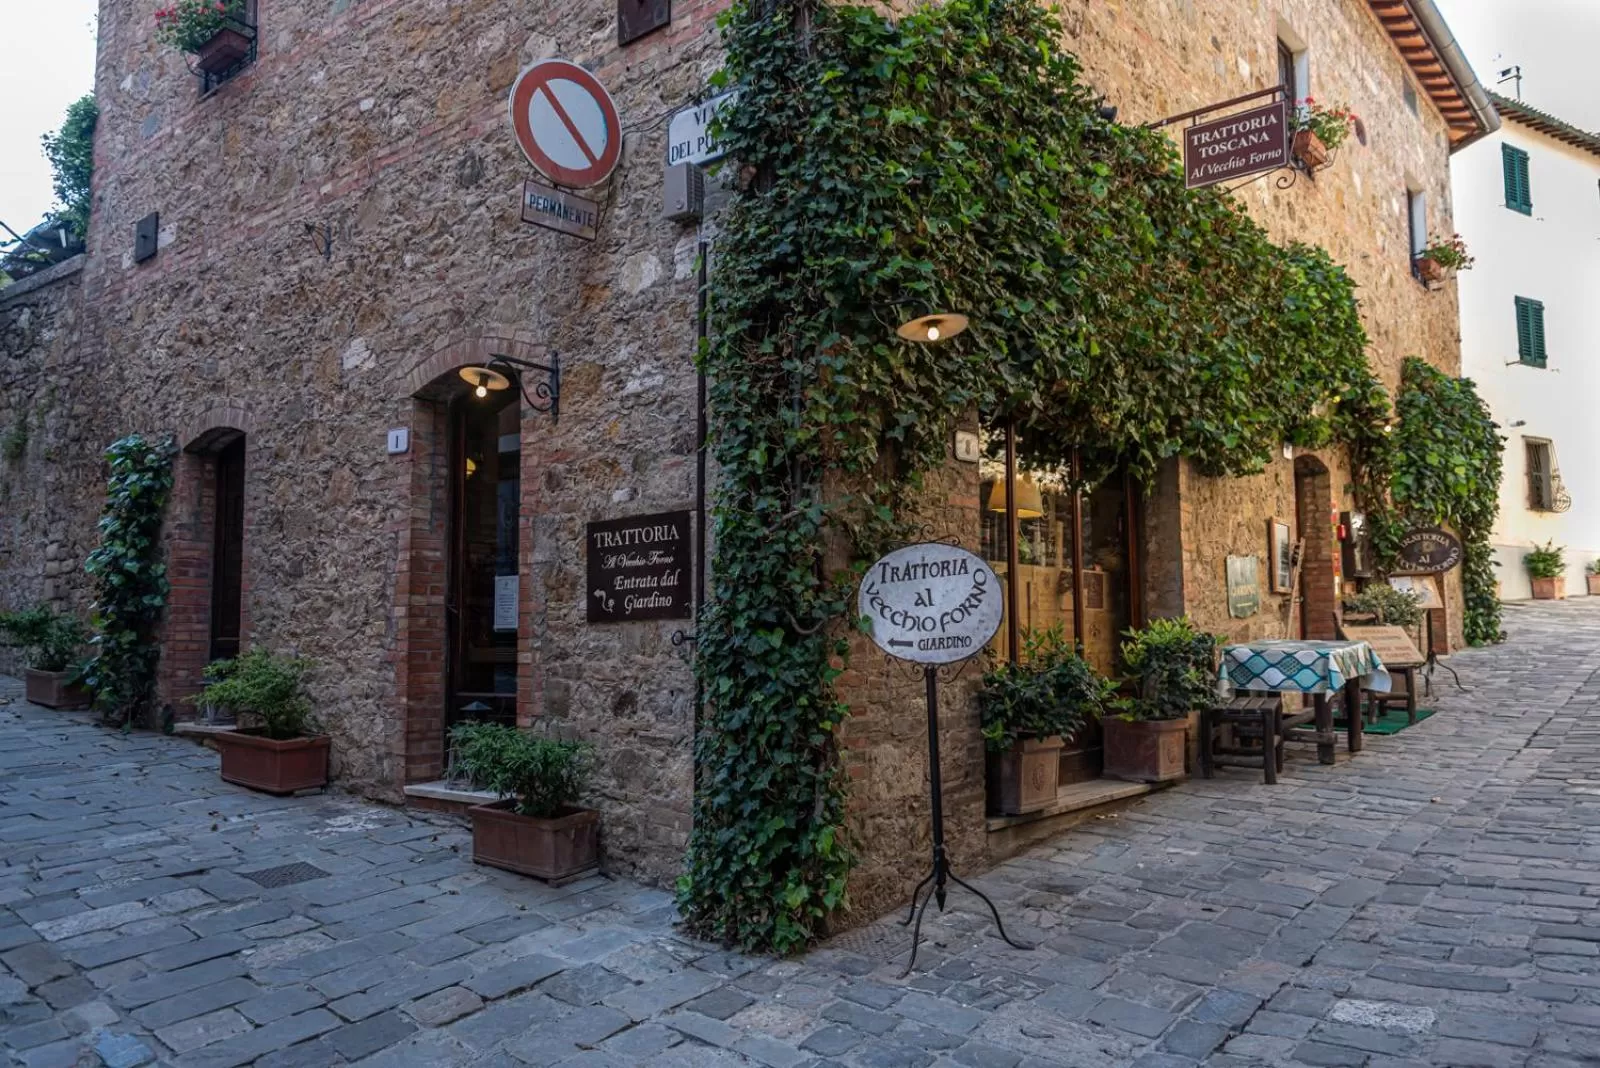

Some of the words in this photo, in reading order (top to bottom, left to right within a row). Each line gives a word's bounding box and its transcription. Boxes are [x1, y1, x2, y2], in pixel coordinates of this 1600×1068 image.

[1191, 113, 1278, 146] TRATTORIA
[671, 141, 694, 163] DEL
[1198, 131, 1270, 159] TOSCANA
[1190, 163, 1206, 179] Al
[1207, 156, 1246, 176] Vecchio
[1248, 148, 1282, 165] Forno
[529, 193, 595, 229] PERMANENTE
[594, 524, 680, 548] TRATTORIA
[614, 575, 659, 591] Entrata
[660, 569, 681, 587] dal
[879, 557, 969, 584] TRATTORIA
[624, 591, 673, 615] Giardino
[914, 588, 935, 608] al
[918, 635, 973, 651] GIARDINO
